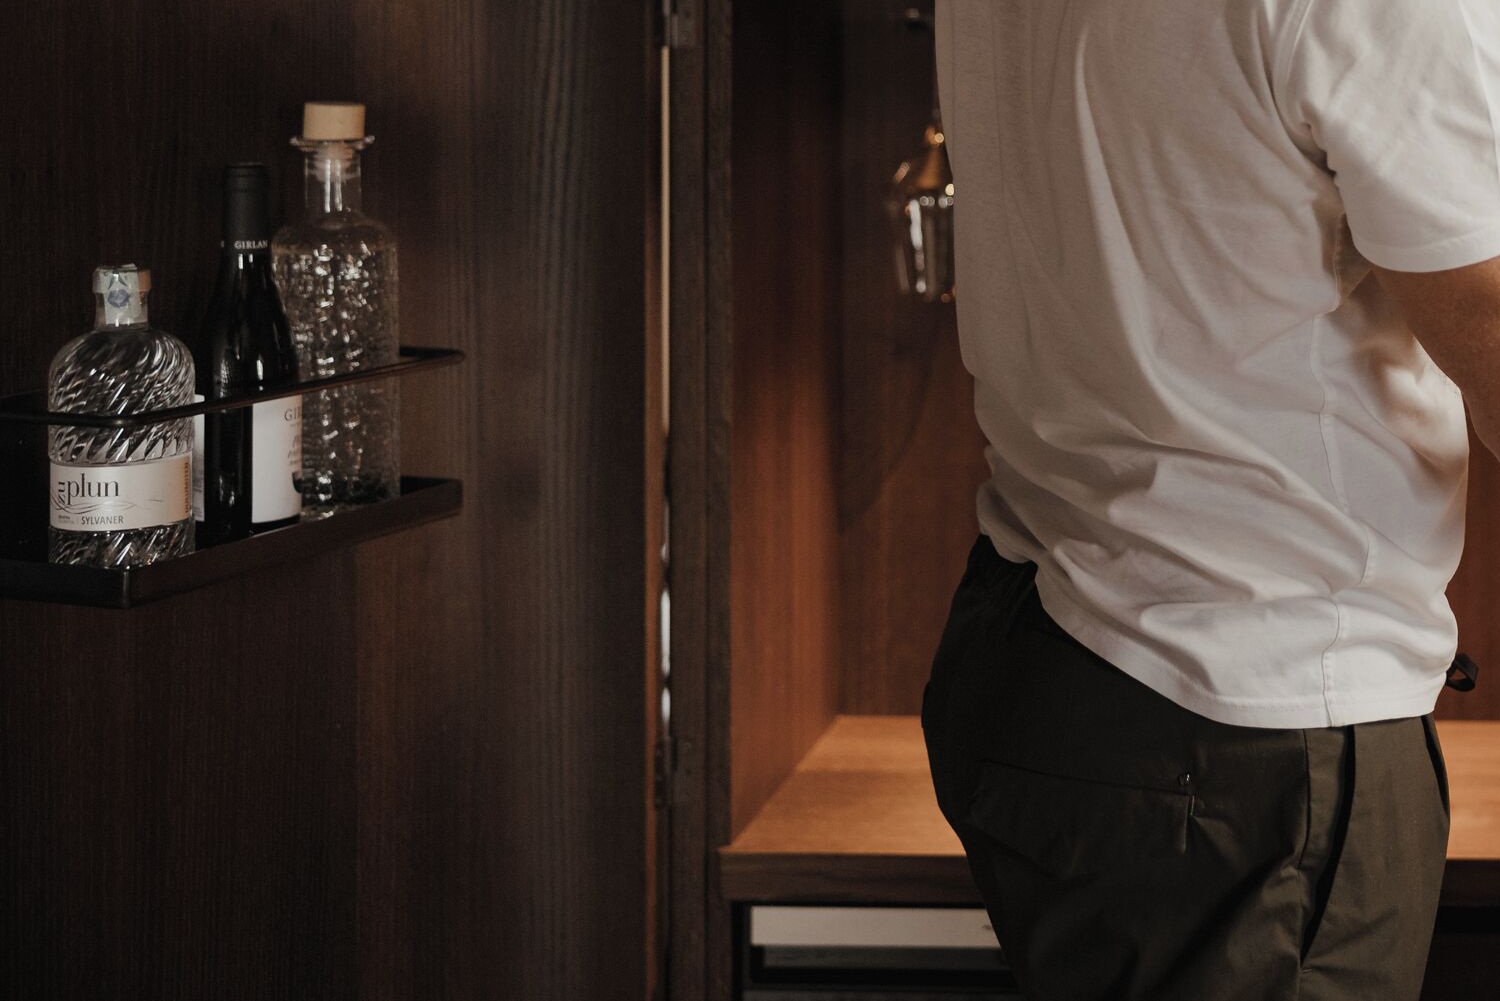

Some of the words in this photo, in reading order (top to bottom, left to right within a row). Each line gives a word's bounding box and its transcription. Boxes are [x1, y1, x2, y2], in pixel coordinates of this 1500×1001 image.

[234, 240, 268, 249] GIRLAN
[67, 473, 119, 505] plun
[81, 515, 124, 525] SYLVANER
